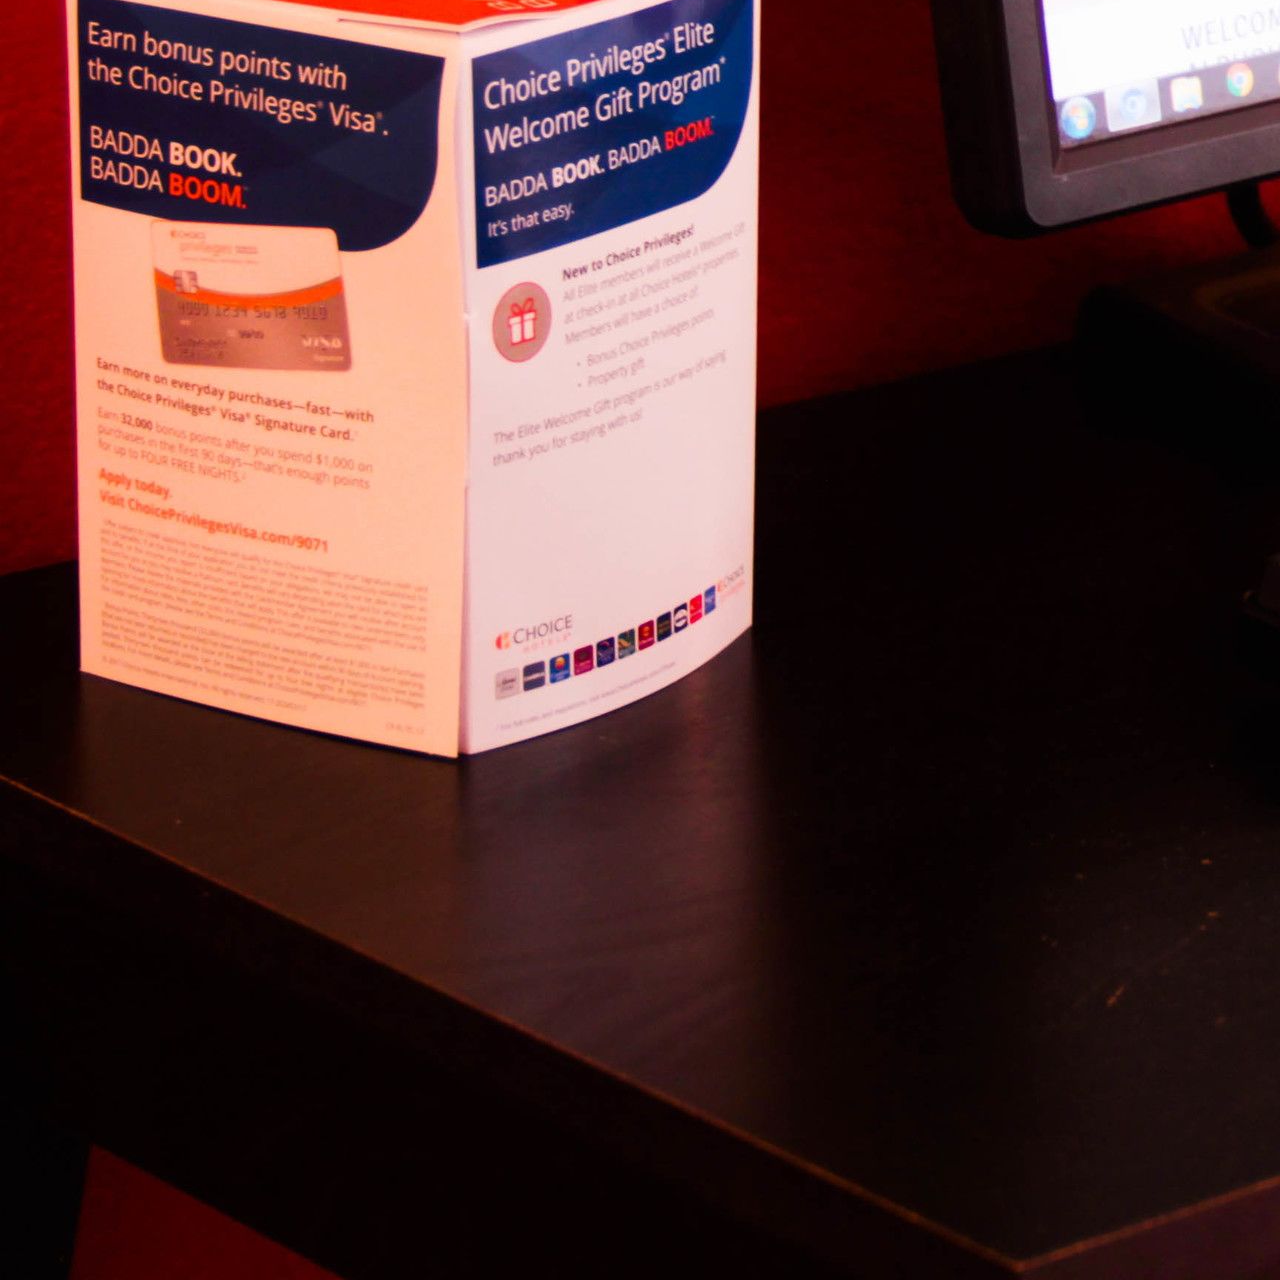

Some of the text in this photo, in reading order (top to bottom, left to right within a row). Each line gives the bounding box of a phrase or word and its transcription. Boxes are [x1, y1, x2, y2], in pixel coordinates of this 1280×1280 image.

[87, 21, 348, 91] Earn bonus points with
[484, 69, 562, 111] Choice
[673, 20, 715, 55] Elite
[87, 58, 122, 85] the
[128, 65, 204, 101] Choice
[484, 105, 590, 155] Welcome
[594, 86, 633, 122] Gift
[90, 125, 243, 178] BADDA BOOK.
[484, 172, 548, 207] BADDA
[552, 154, 605, 189] BOOK.
[607, 135, 662, 170] BADDA
[90, 156, 164, 194] BADDA
[511, 209, 539, 234] that
[542, 201, 575, 225] easy.
[563, 265, 588, 281] New
[591, 260, 603, 272] to
[606, 246, 641, 266] Choice
[97, 357, 120, 373] Earn
[123, 365, 151, 382] more
[154, 374, 168, 386] on
[171, 378, 225, 400] everyday
[97, 379, 115, 393] the
[117, 383, 152, 403] Choice
[255, 414, 317, 436] Signature
[99, 467, 132, 491] Apply
[141, 449, 168, 466] FOUR
[99, 488, 125, 508] Visit
[513, 614, 574, 645] CHOICE
